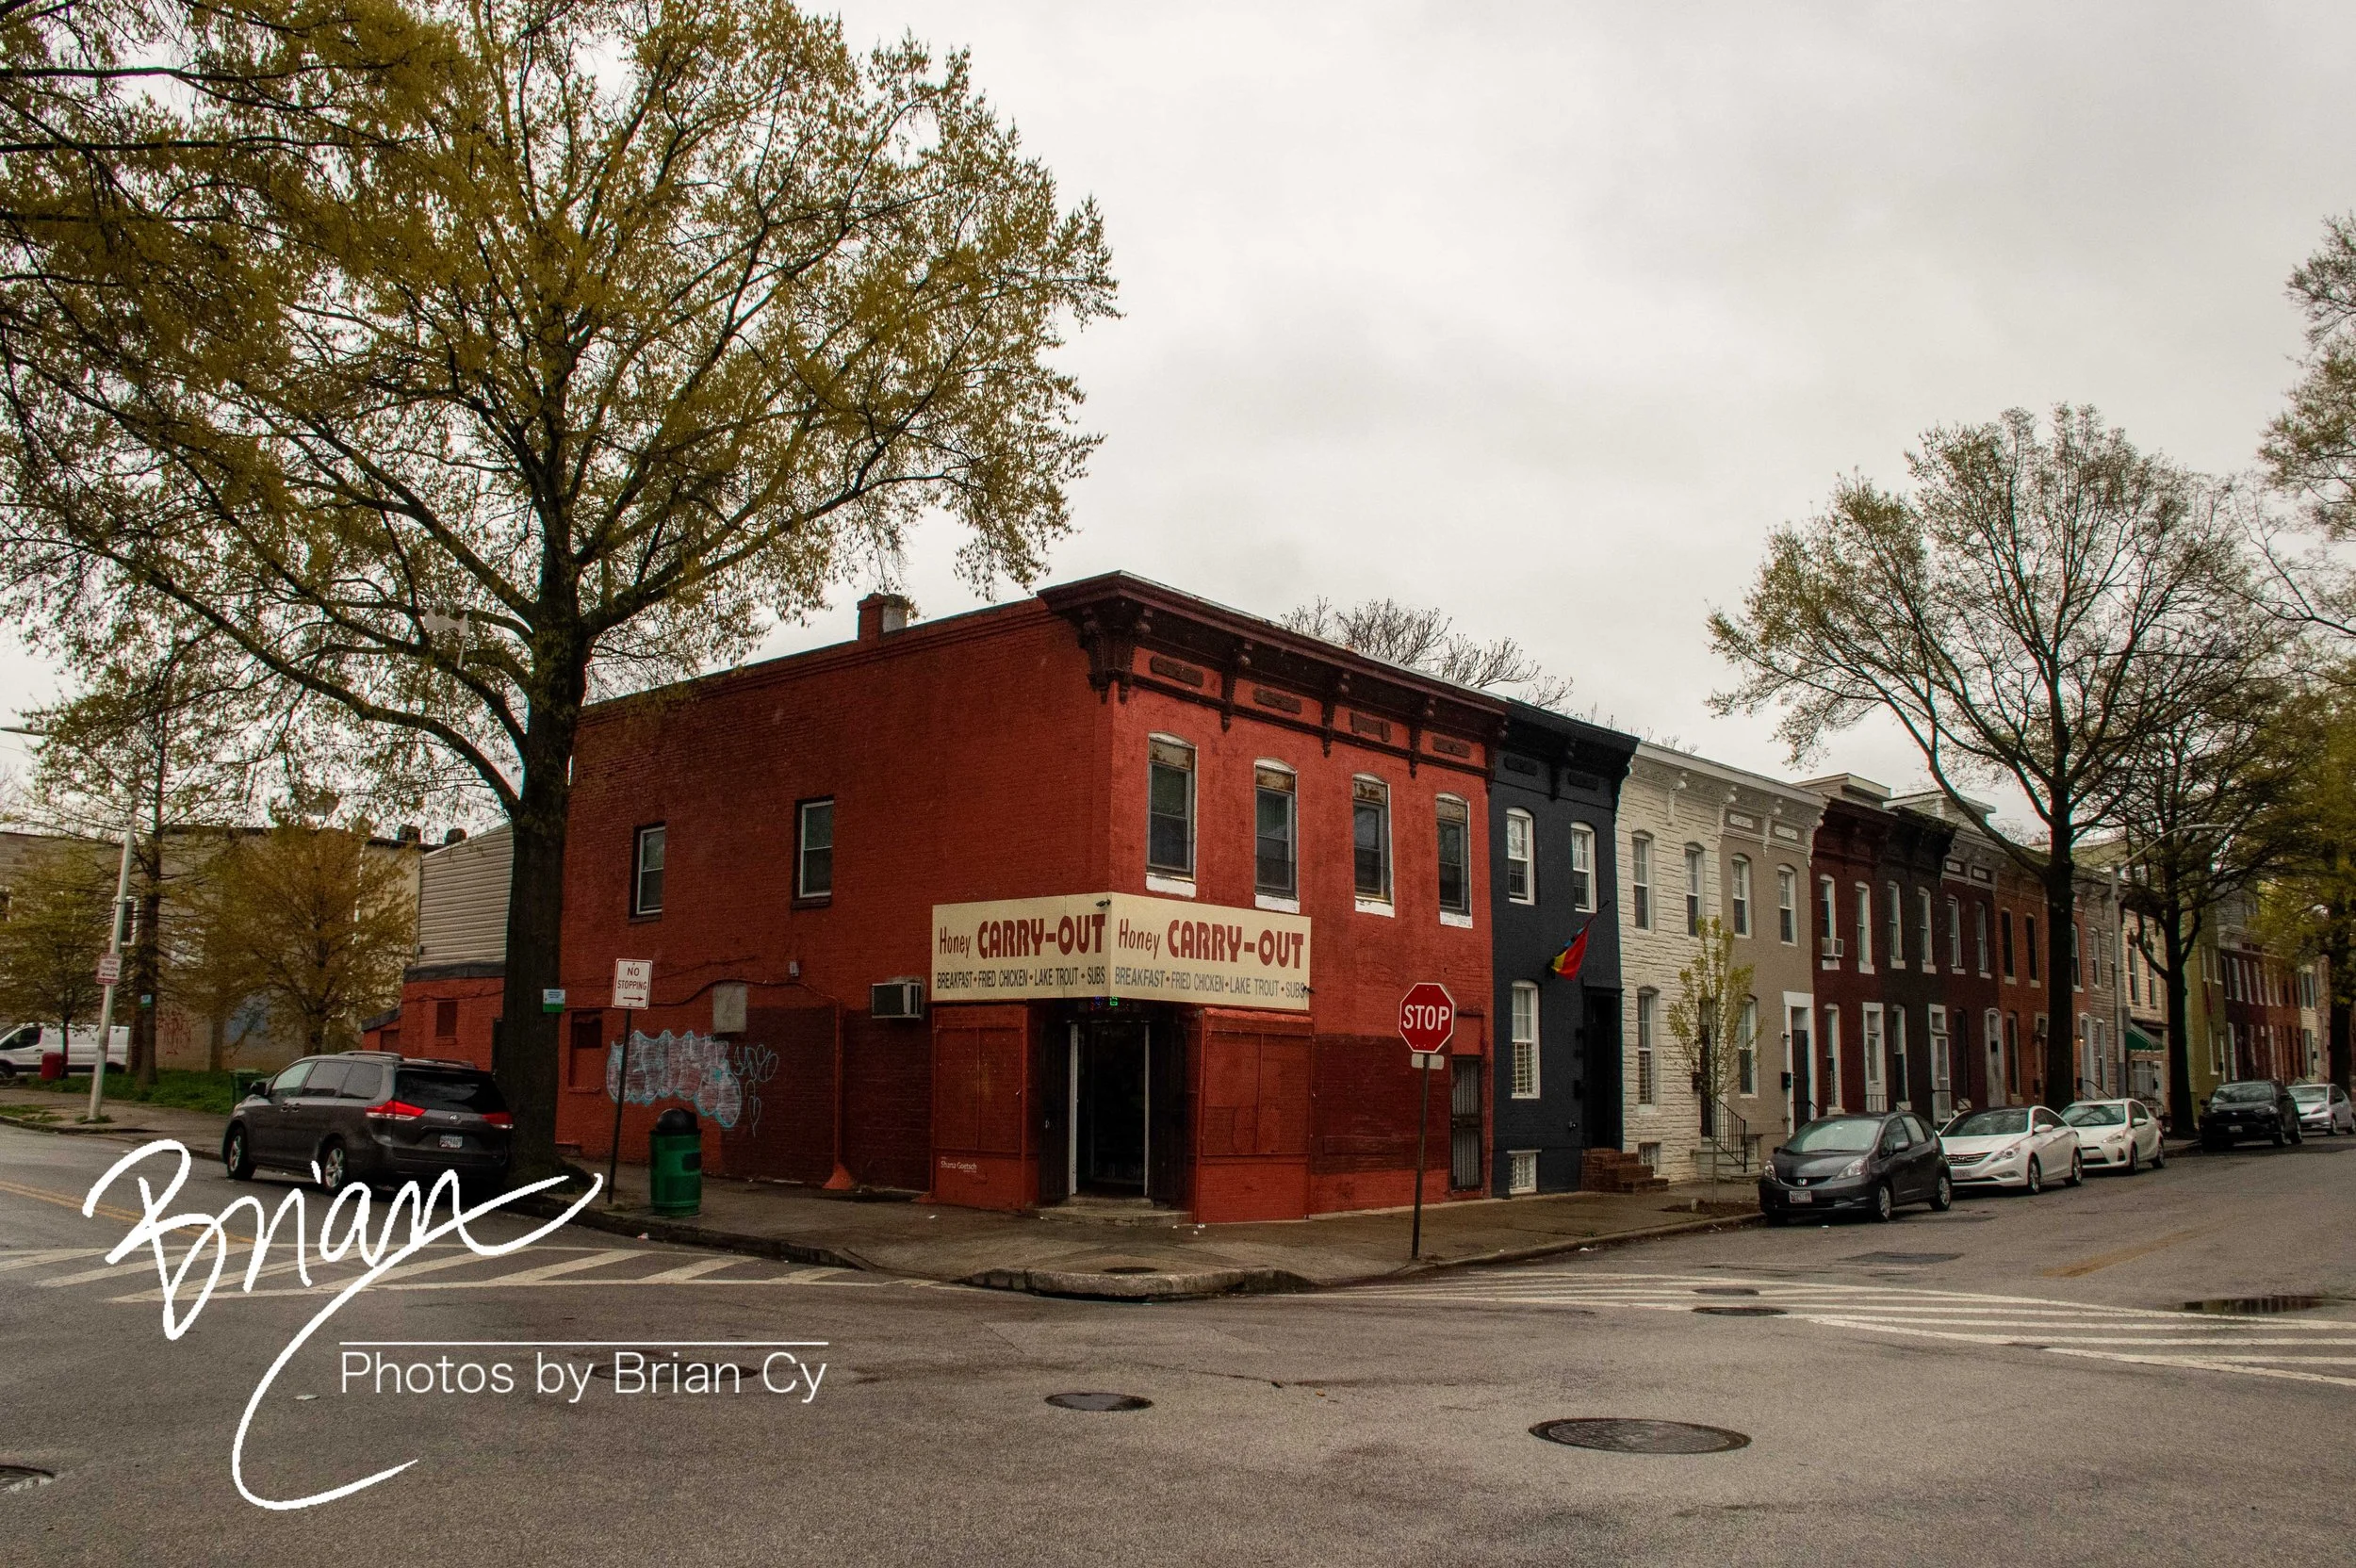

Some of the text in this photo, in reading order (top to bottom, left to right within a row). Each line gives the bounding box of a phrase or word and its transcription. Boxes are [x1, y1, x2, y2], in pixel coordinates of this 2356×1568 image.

[940, 914, 1105, 959] Honey CARRY-OUT
[1118, 918, 1304, 970] Honey CARRY-OUT
[617, 980, 647, 990] STOPPING
[627, 967, 640, 976] NO
[937, 966, 1105, 988] BREAKFAST FRIED CHICKEN LAKE TROUT SUBS
[1115, 966, 1305, 999] BREAKFAST FRIED CHICKEN LAKE TROUT SUBS
[1402, 1004, 1450, 1031] STOP
